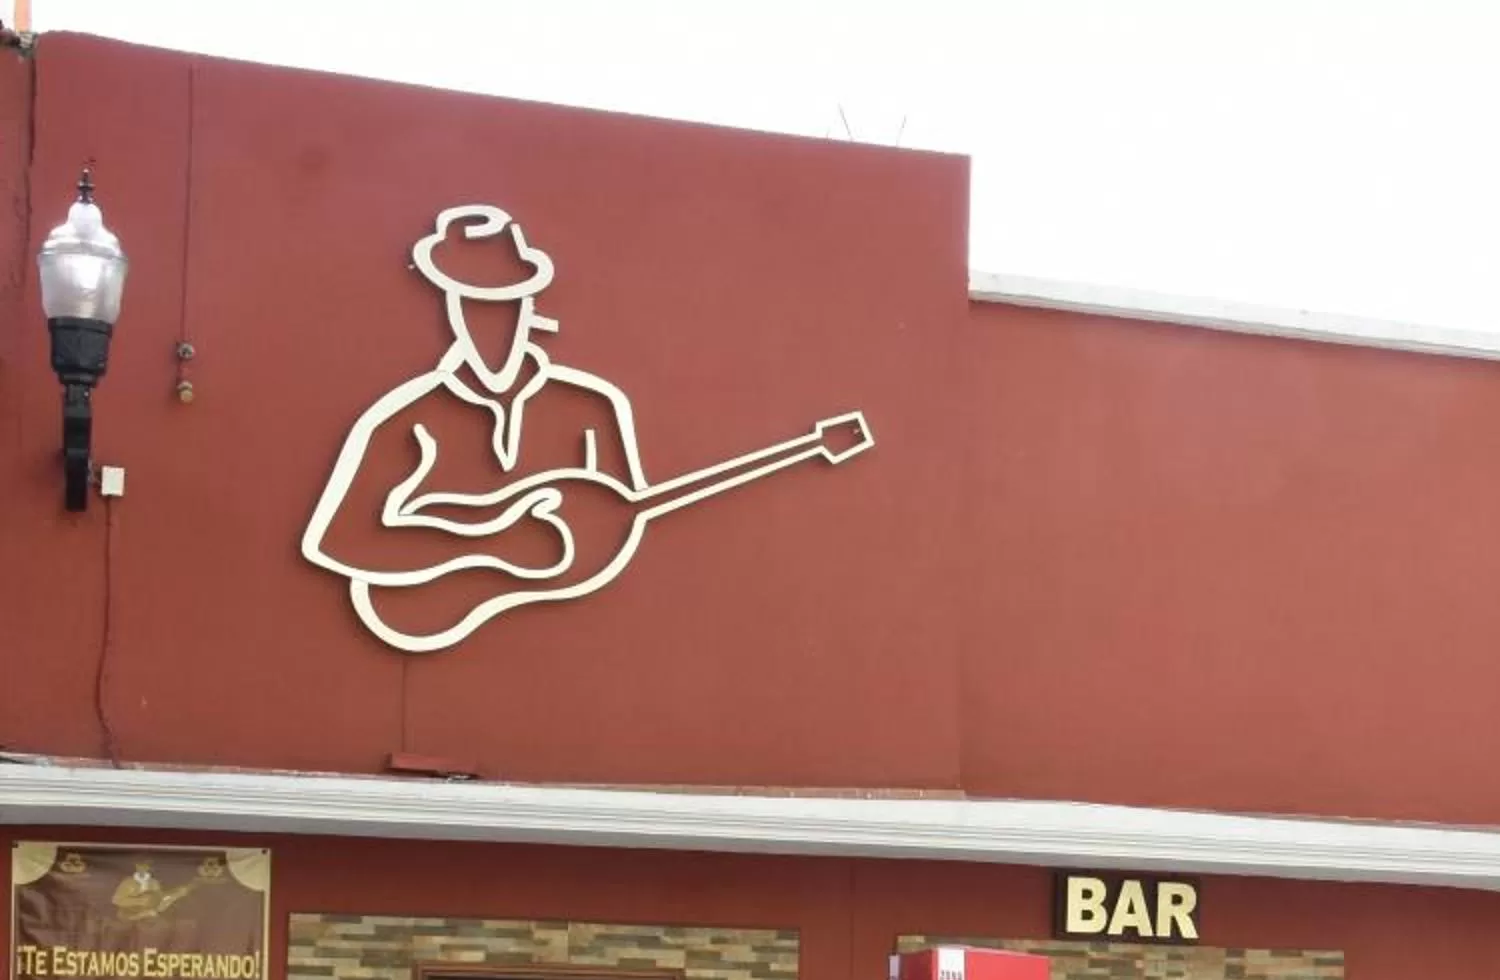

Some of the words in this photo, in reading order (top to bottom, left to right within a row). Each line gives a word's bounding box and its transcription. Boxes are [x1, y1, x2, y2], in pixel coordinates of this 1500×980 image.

[1066, 876, 1199, 939] BAR
[53, 946, 140, 977] ESTAMOS
[143, 948, 260, 979] ESPERANDO!
